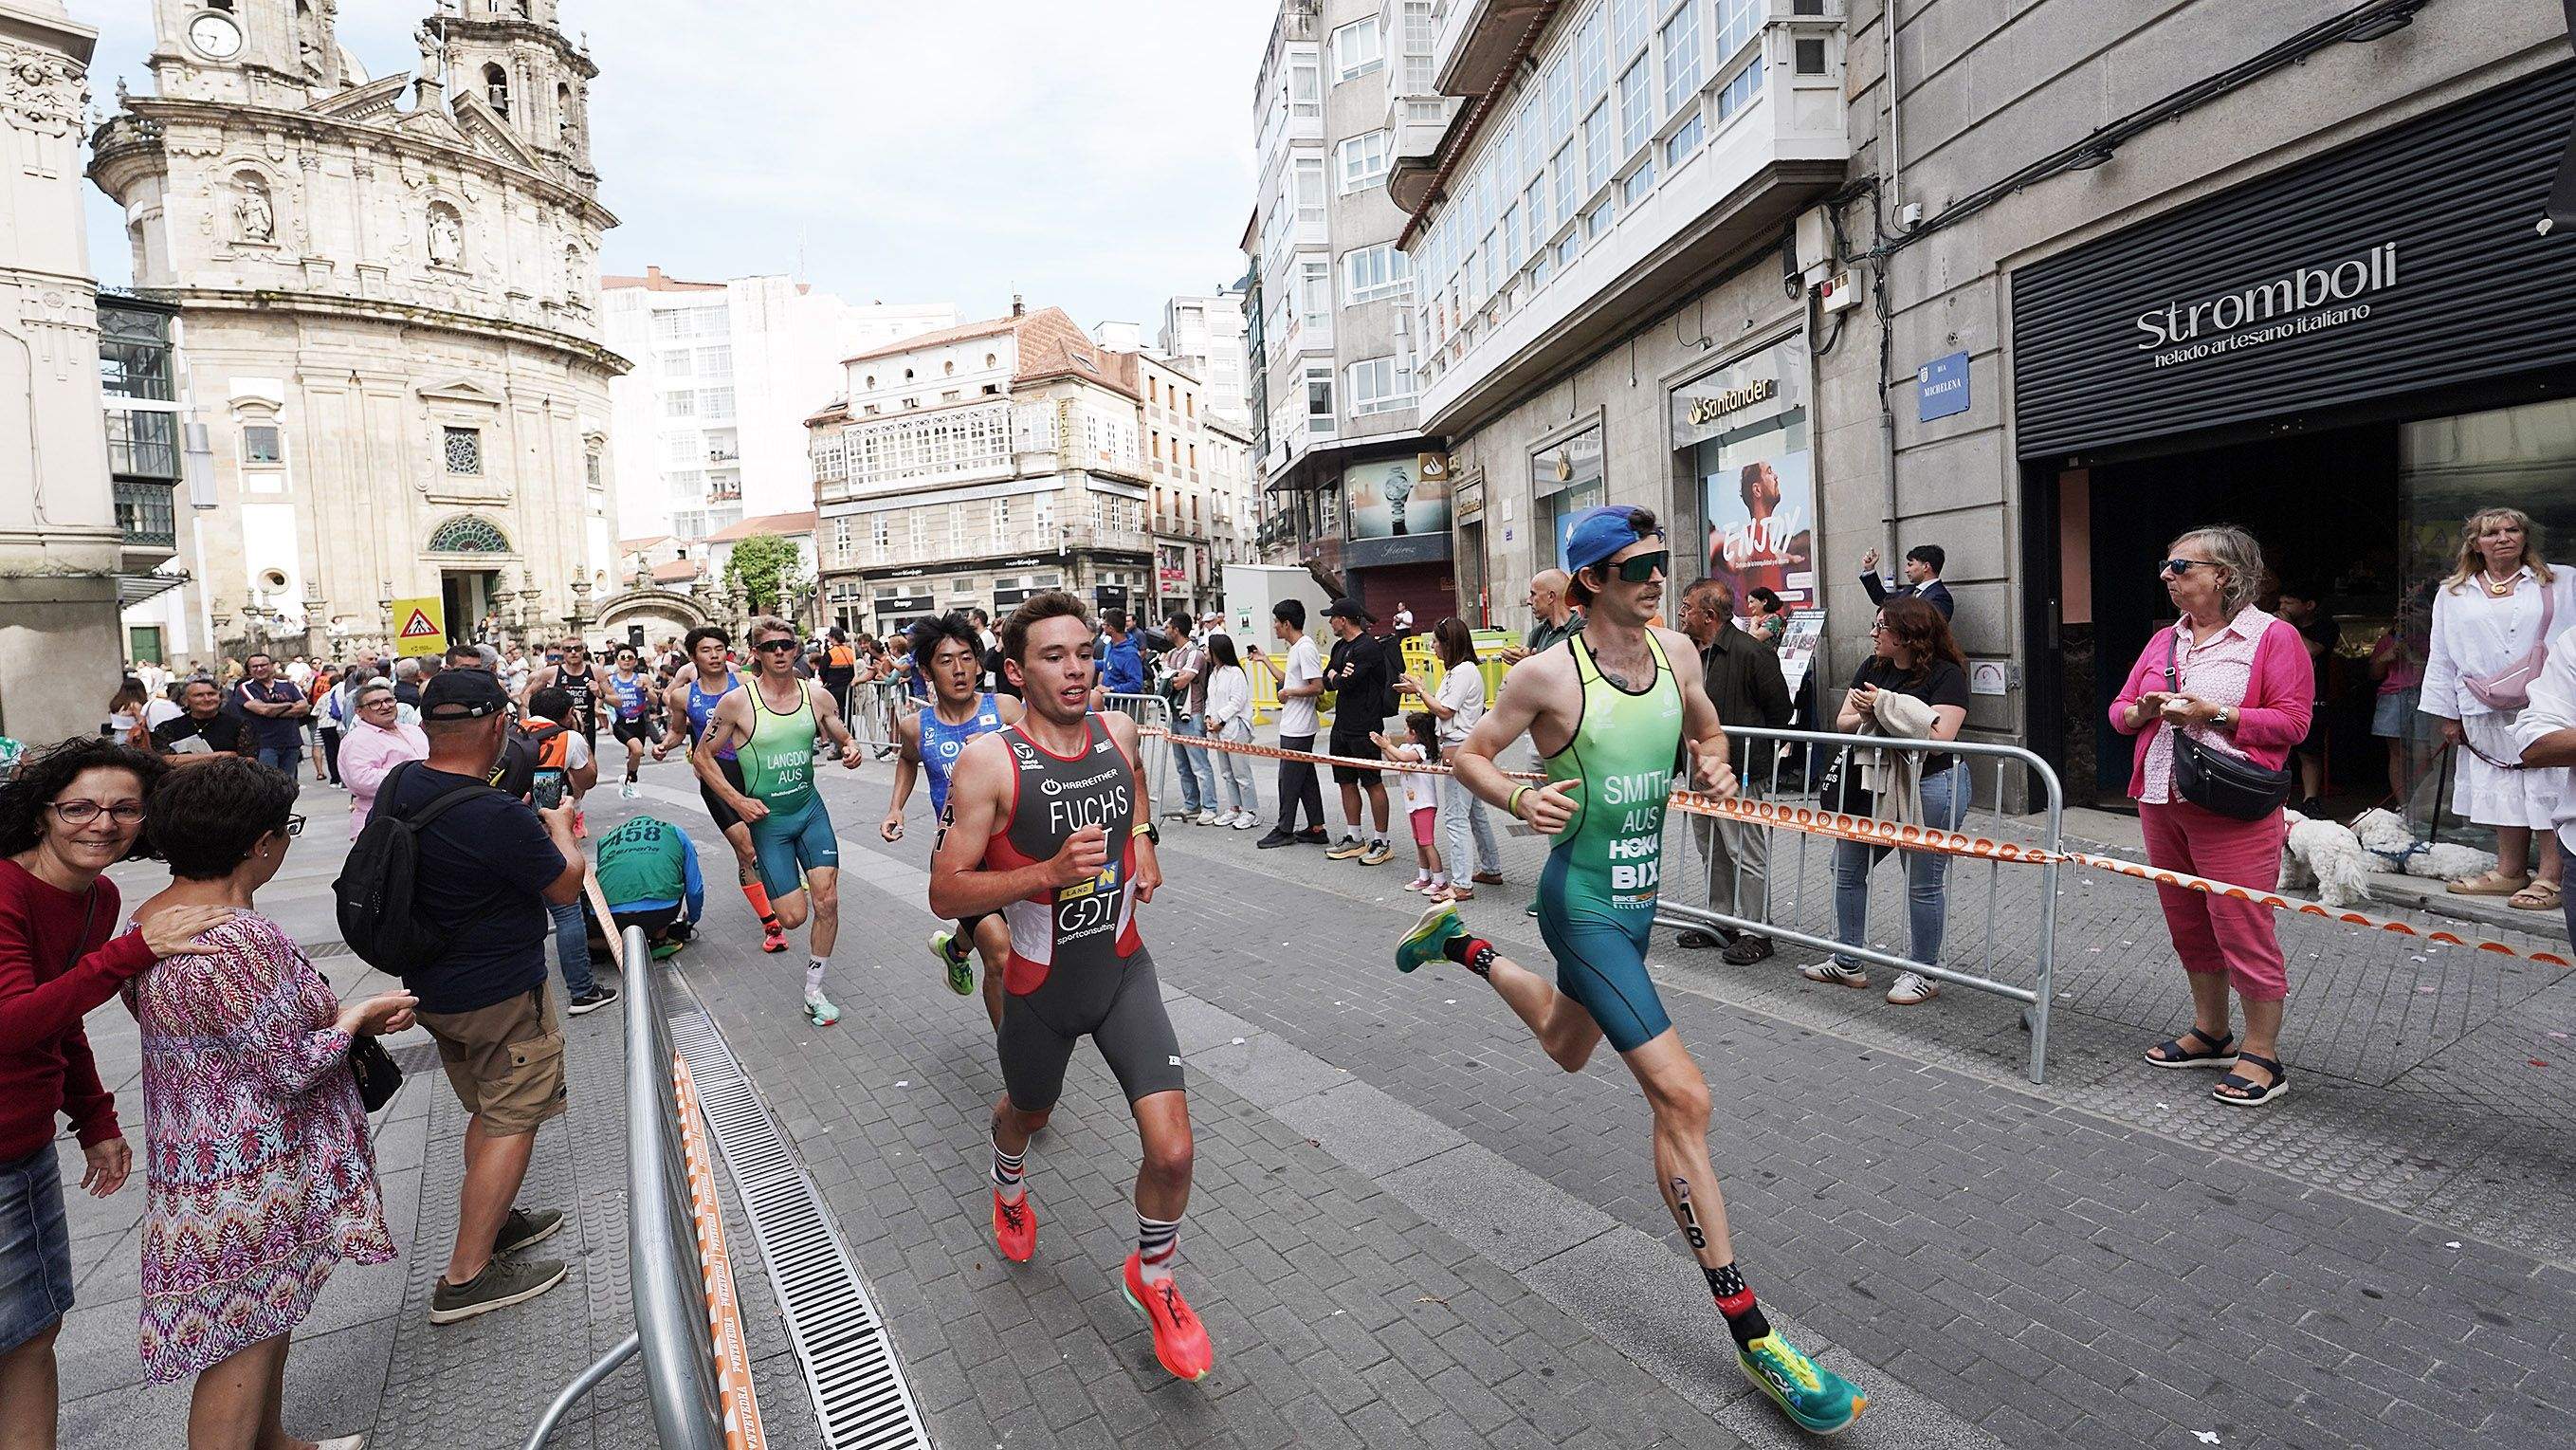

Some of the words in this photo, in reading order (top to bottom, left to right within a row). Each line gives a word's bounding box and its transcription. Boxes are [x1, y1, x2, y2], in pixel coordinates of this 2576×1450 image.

[2136, 242, 2397, 350] Stromboli
[2212, 323, 2294, 354] artesano
[2297, 304, 2371, 334] italiano
[1702, 378, 1769, 421] Santander
[1925, 377, 1962, 396] MICHELENA
[1723, 505, 1801, 561] ENJOY
[778, 768, 802, 784] AUS
[1062, 769, 1119, 791] HARREITHER
[1604, 768, 1673, 805] SMITH
[1050, 785, 1128, 835] FUCHS
[1620, 806, 1659, 834] AUS
[604, 826, 661, 845] 458
[1609, 833, 1659, 859] HOKA
[1066, 886, 1089, 896] LAND
[1059, 890, 1121, 931] GDT
[1057, 923, 1116, 945] sportconsulting
[1679, 1202, 1707, 1249] 18
